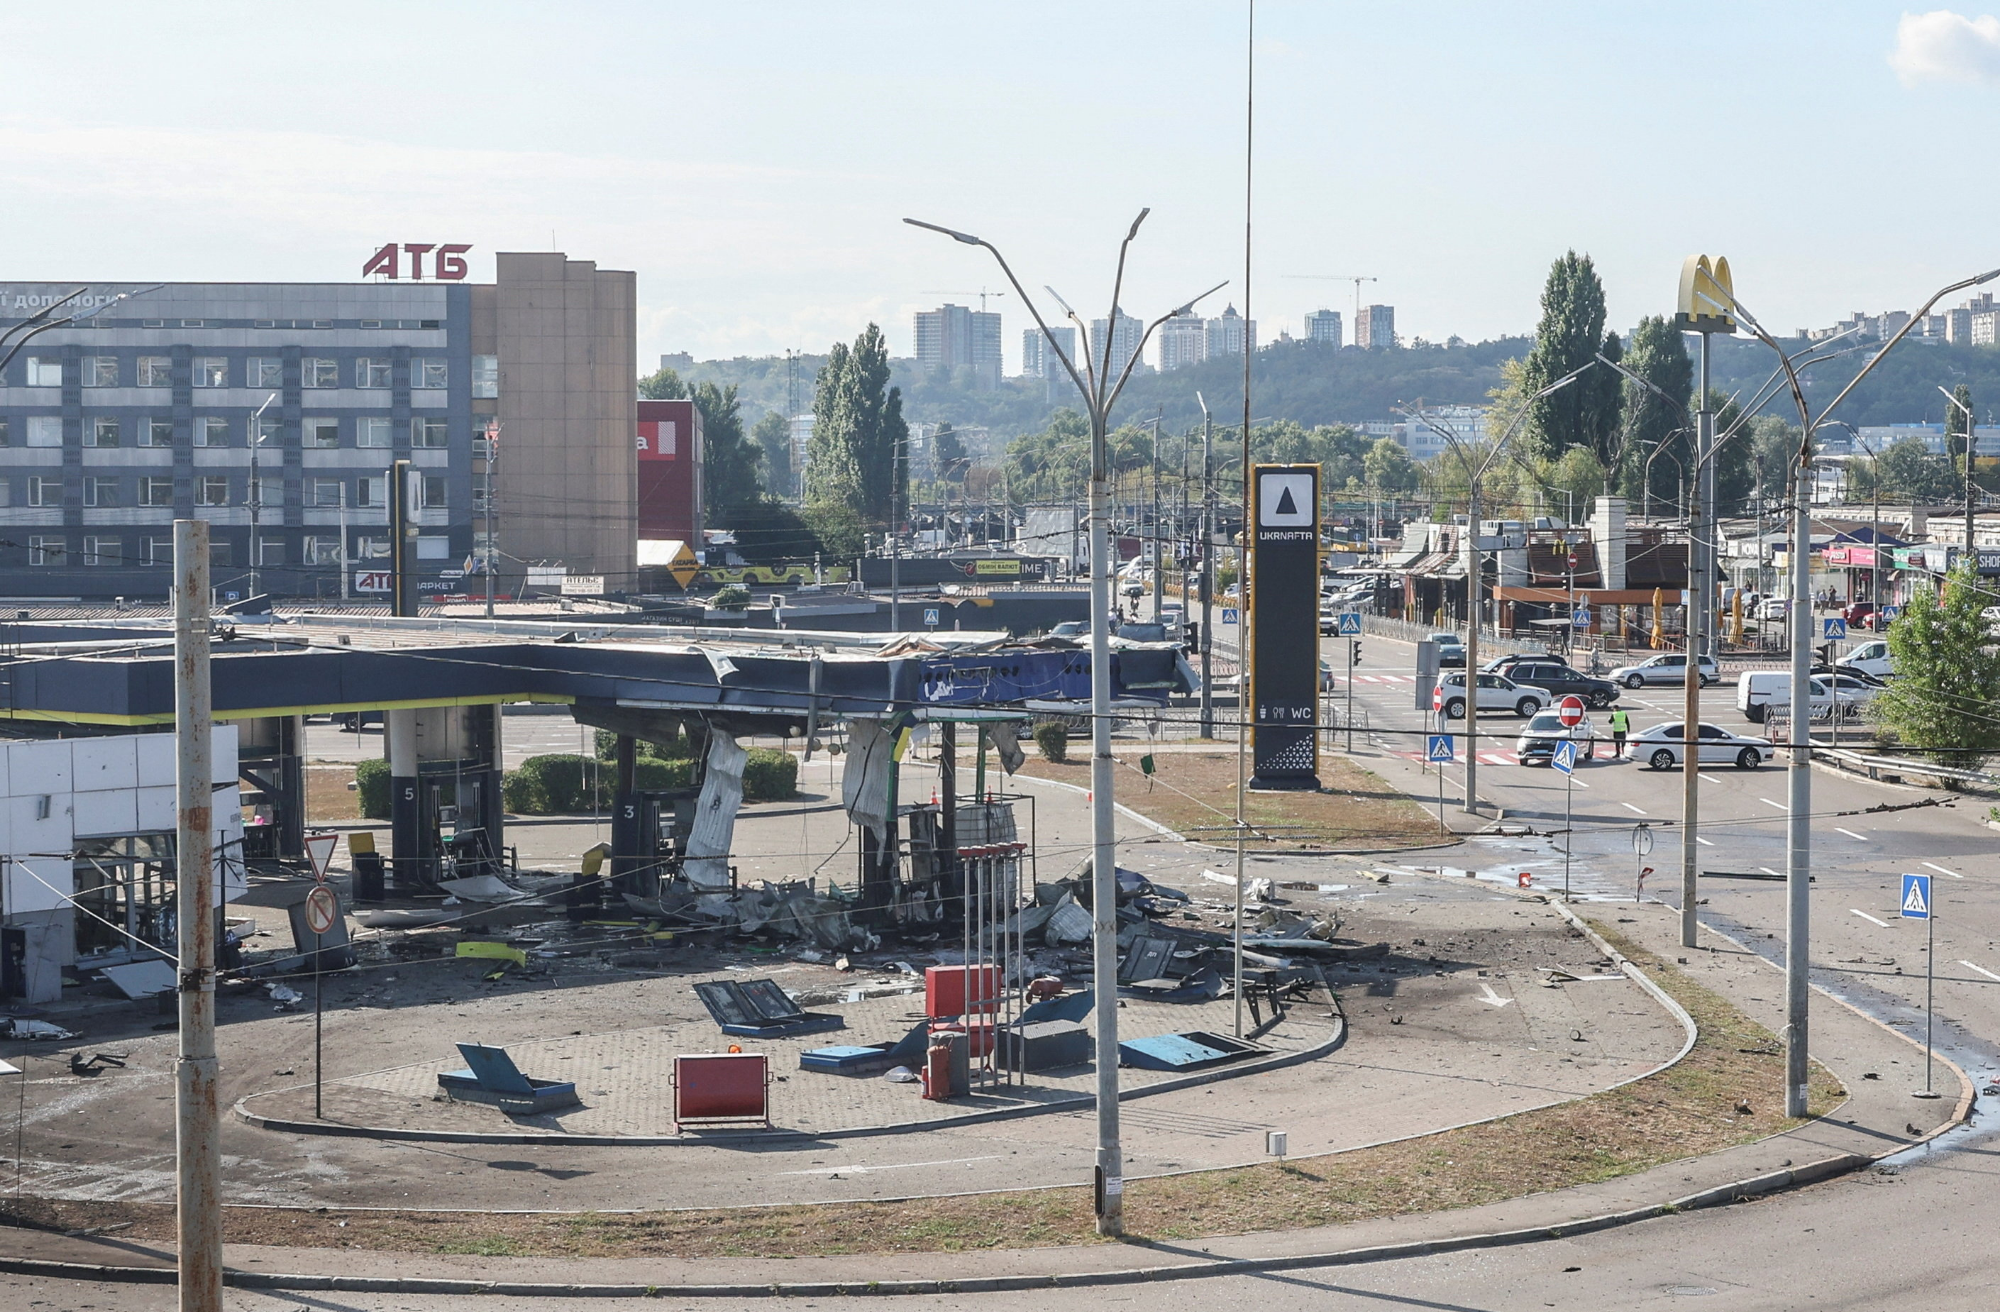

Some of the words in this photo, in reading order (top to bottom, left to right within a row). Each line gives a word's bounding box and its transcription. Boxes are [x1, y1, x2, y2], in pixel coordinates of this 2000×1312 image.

[363, 243, 474, 280] АТБ
[1259, 531, 1313, 540] UKRNAFTA
[1020, 563, 1043, 574] IME
[359, 573, 391, 589] АТ
[1291, 707, 1311, 719] WC
[405, 787, 414, 801] 5
[624, 805, 635, 819] 3
